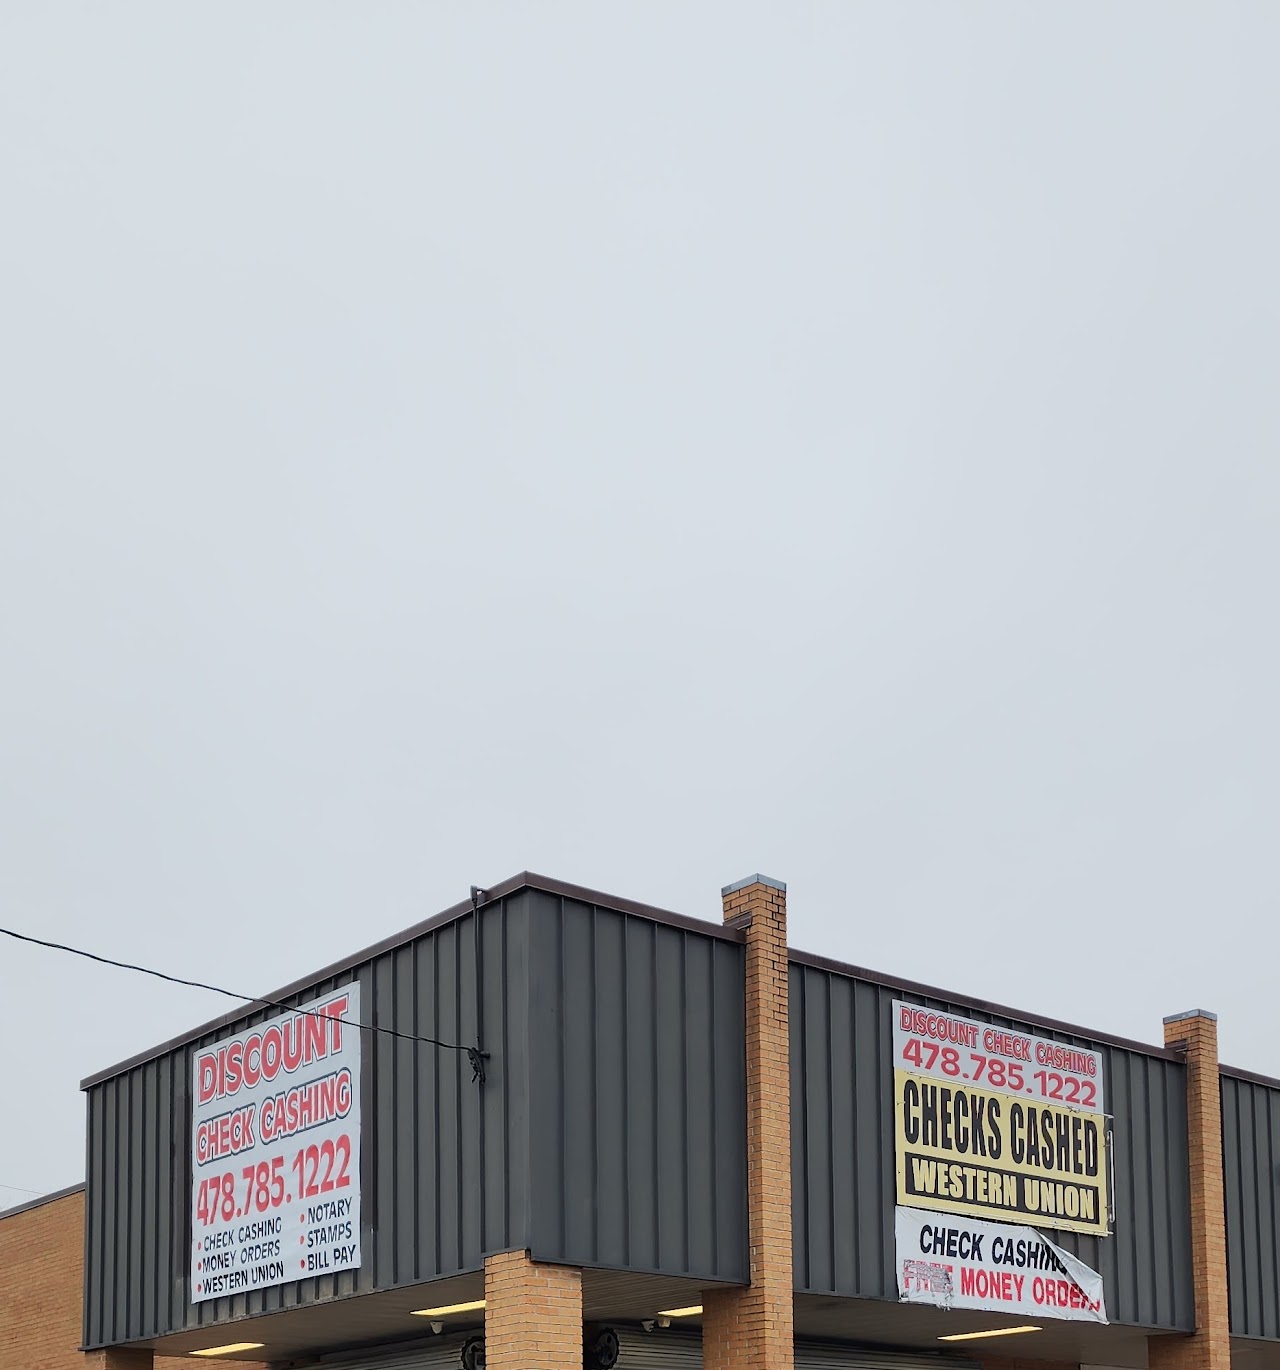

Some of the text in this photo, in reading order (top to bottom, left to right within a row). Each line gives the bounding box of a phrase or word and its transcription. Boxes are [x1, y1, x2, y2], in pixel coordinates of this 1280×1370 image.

[198, 993, 349, 1107] DISCOUNT
[900, 1006, 1097, 1077] DISCOUNT CHECK CASHING
[903, 1038, 1097, 1108] 478.785.1222
[197, 1067, 352, 1167] CHECK CASHING
[903, 1079, 1098, 1178] CHECKS CASHED
[197, 1133, 350, 1226] 478.785.1222
[911, 1157, 1095, 1220] WESTERN UNION
[308, 1197, 353, 1224] NOTARY
[204, 1217, 282, 1252] CHECK CASHING
[307, 1221, 352, 1248] STAMPS
[920, 1225, 984, 1262] CHECK
[202, 1239, 280, 1273] MONEY ORDERS
[308, 1245, 357, 1271] BILL PAY
[202, 1261, 284, 1294] WESTERN UNION
[961, 1267, 1025, 1302] MONEY
